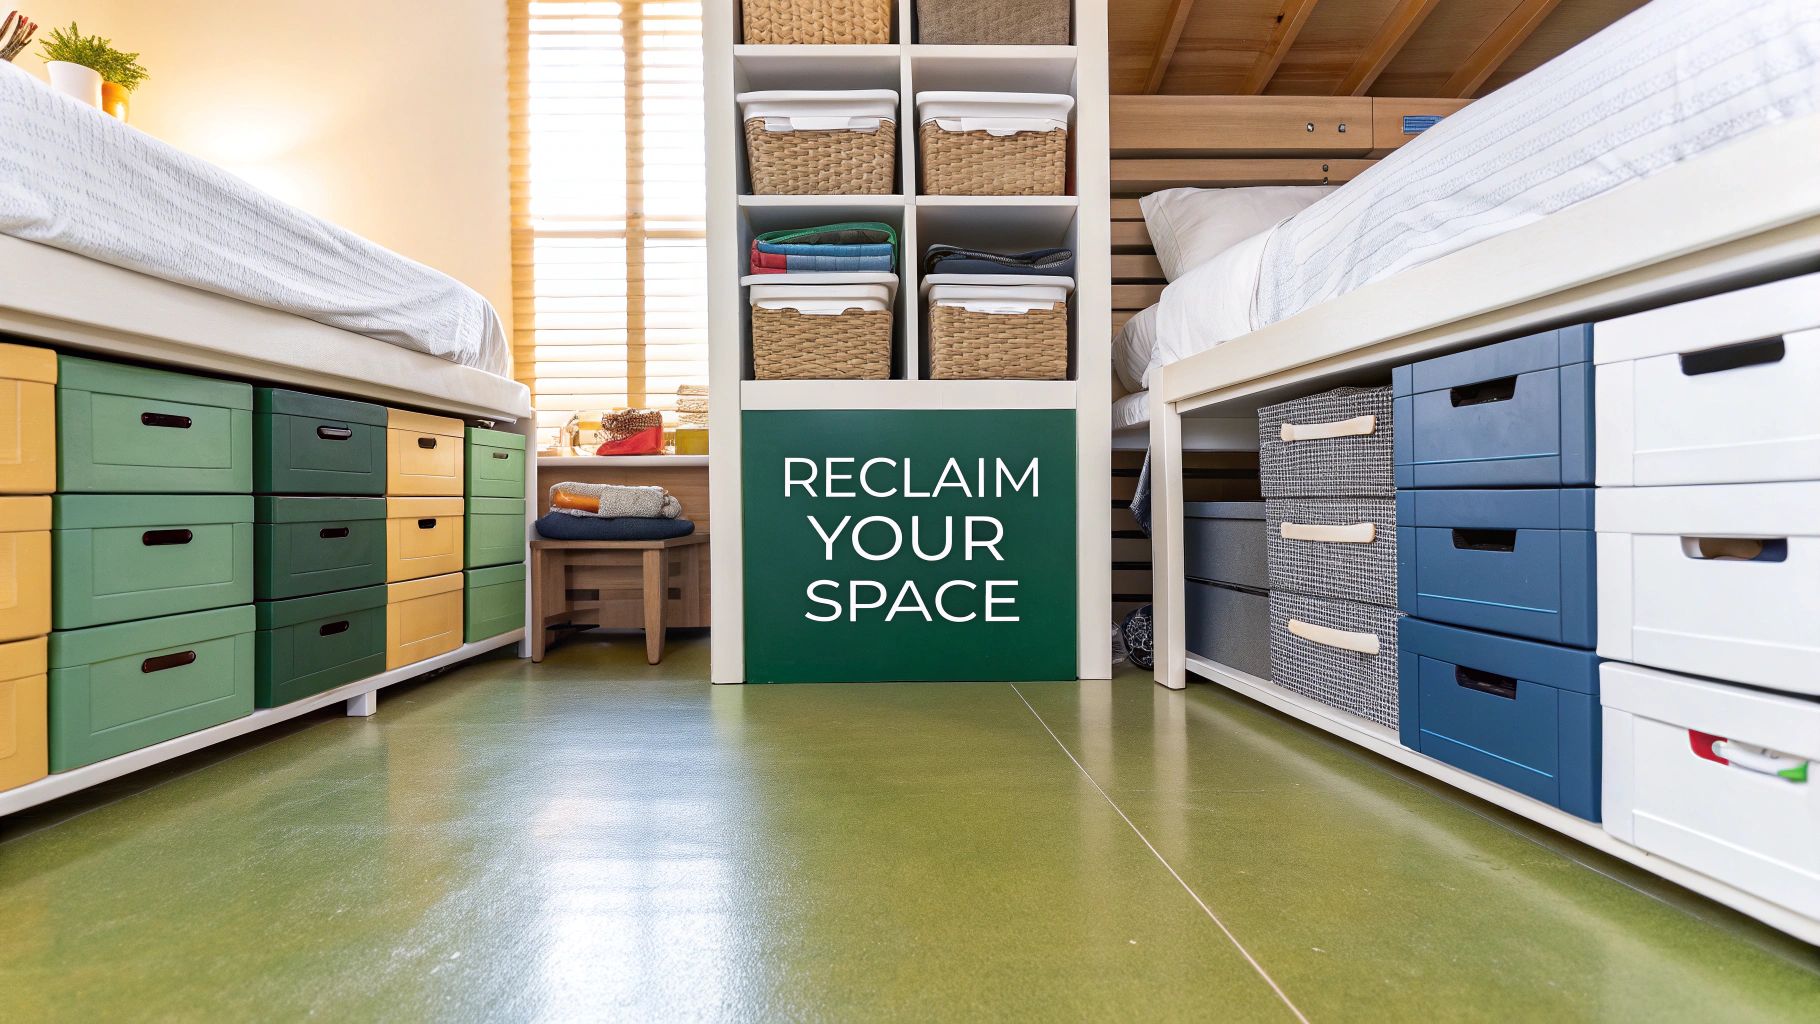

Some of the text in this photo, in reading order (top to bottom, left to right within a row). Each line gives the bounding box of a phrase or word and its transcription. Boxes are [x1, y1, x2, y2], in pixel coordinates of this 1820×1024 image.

[784, 457, 1039, 498] RECLAIM
[806, 515, 1005, 562] YOUR
[804, 579, 1020, 623] SPACE
